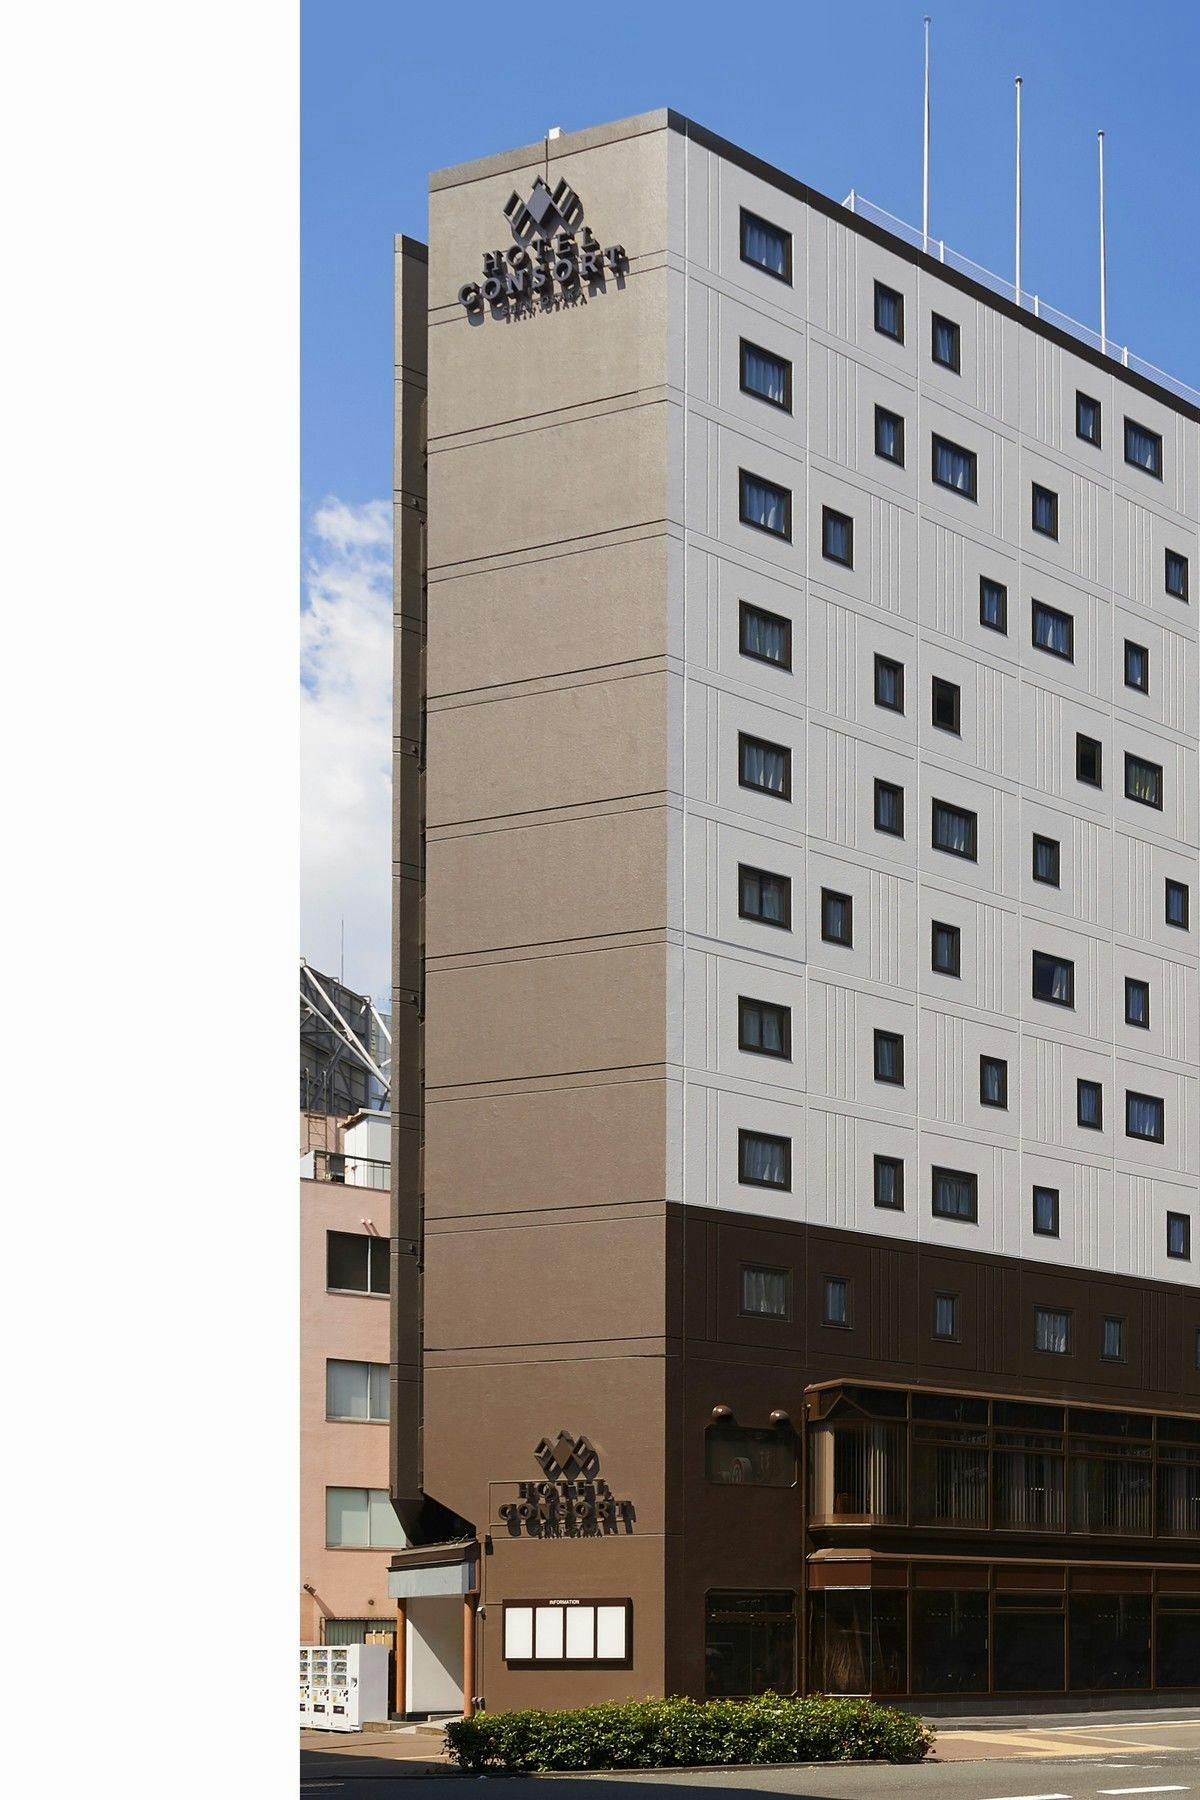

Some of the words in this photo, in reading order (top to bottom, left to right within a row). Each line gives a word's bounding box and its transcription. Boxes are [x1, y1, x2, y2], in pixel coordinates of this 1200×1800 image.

[482, 227, 600, 277] HOTEL
[458, 245, 627, 307] CONSORT
[518, 1480, 612, 1500] HOTEL
[498, 1501, 635, 1521] CONSORT
